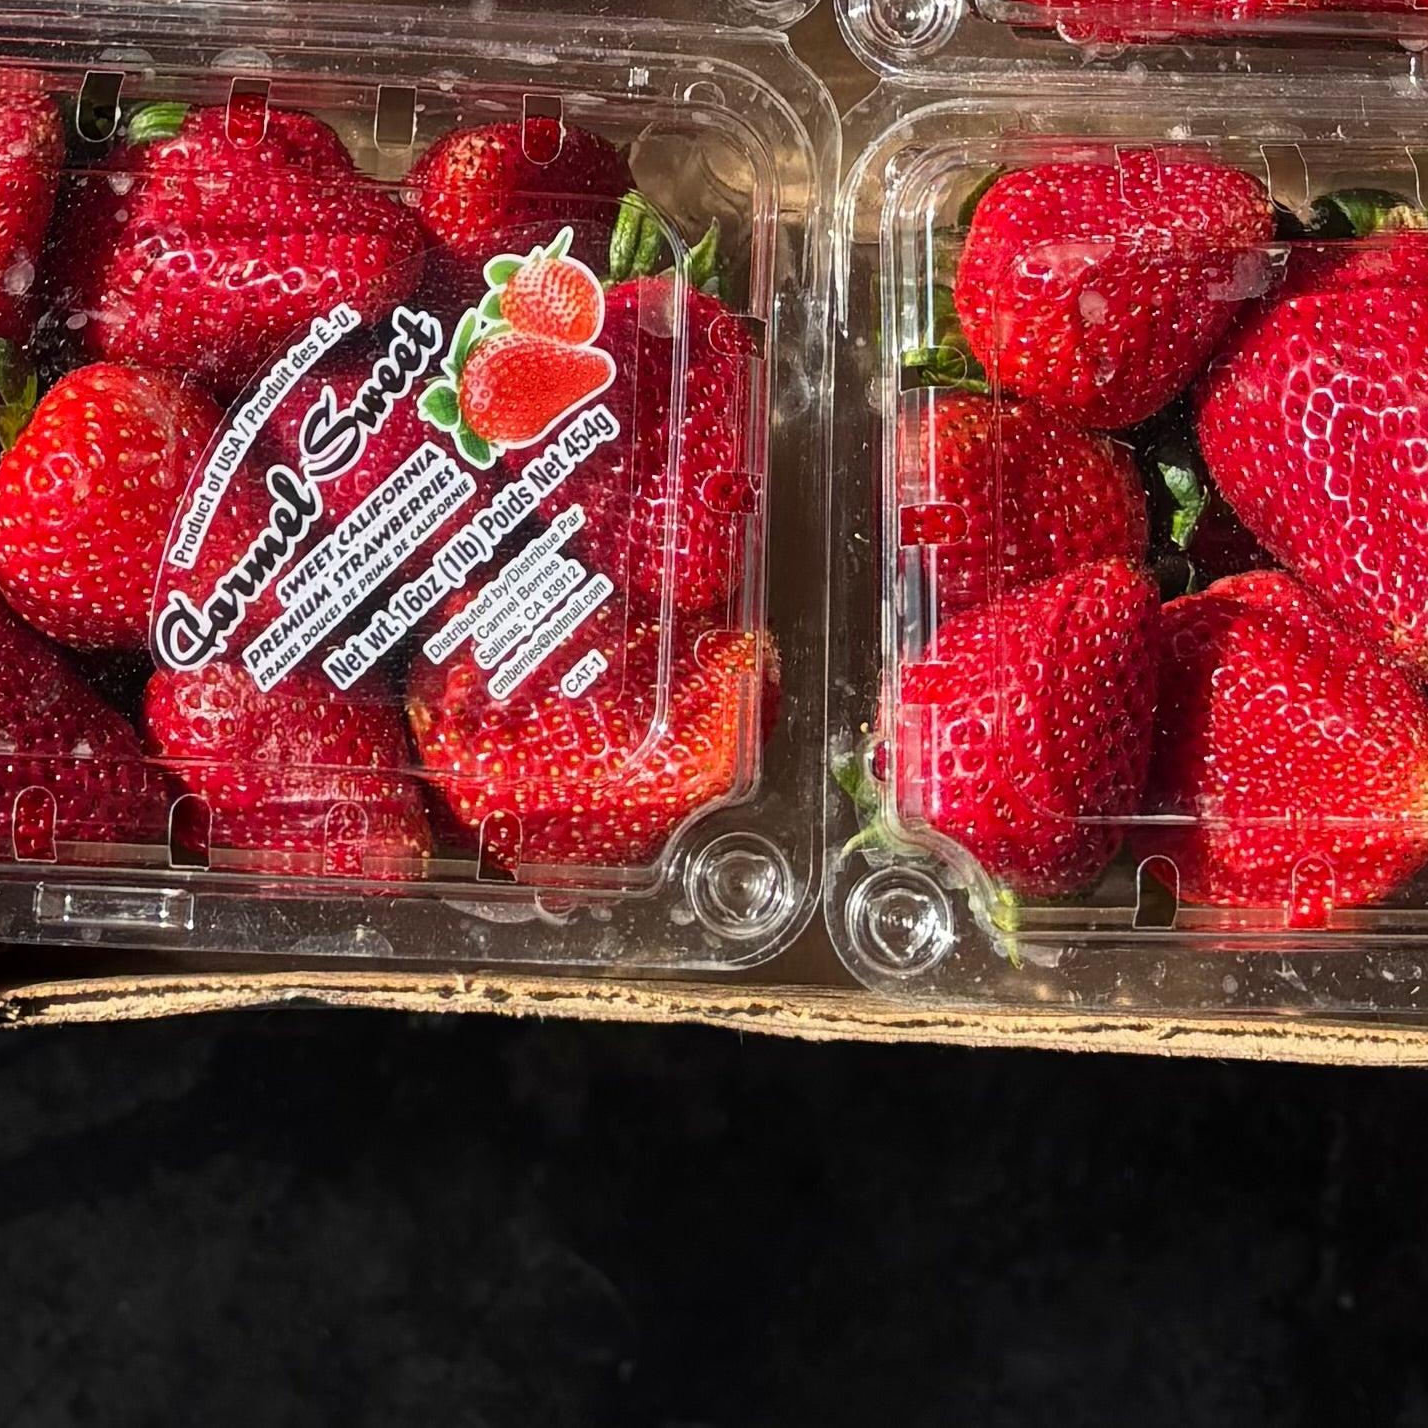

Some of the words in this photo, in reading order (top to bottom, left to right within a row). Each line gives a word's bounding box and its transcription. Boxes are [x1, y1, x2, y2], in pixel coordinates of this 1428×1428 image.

[162, 470, 318, 664] Carmel
[303, 313, 436, 475] Sweet
[247, 583, 333, 670] PREMIUM
[332, 465, 455, 588] STRAWBERRIES
[280, 542, 335, 603] SWEET
[337, 448, 440, 546] CALIFORNIA
[327, 642, 371, 685] Net
[363, 617, 401, 652] wt.
[393, 573, 444, 621] 16oz
[437, 531, 488, 584] (1lb)
[477, 486, 535, 541] Poids
[527, 451, 569, 493] Net
[563, 411, 615, 459] 454g
[478, 622, 528, 665] Salinas,
[523, 600, 546, 621] CA
[541, 565, 581, 604] 93912
[565, 655, 602, 694] CAT-1
